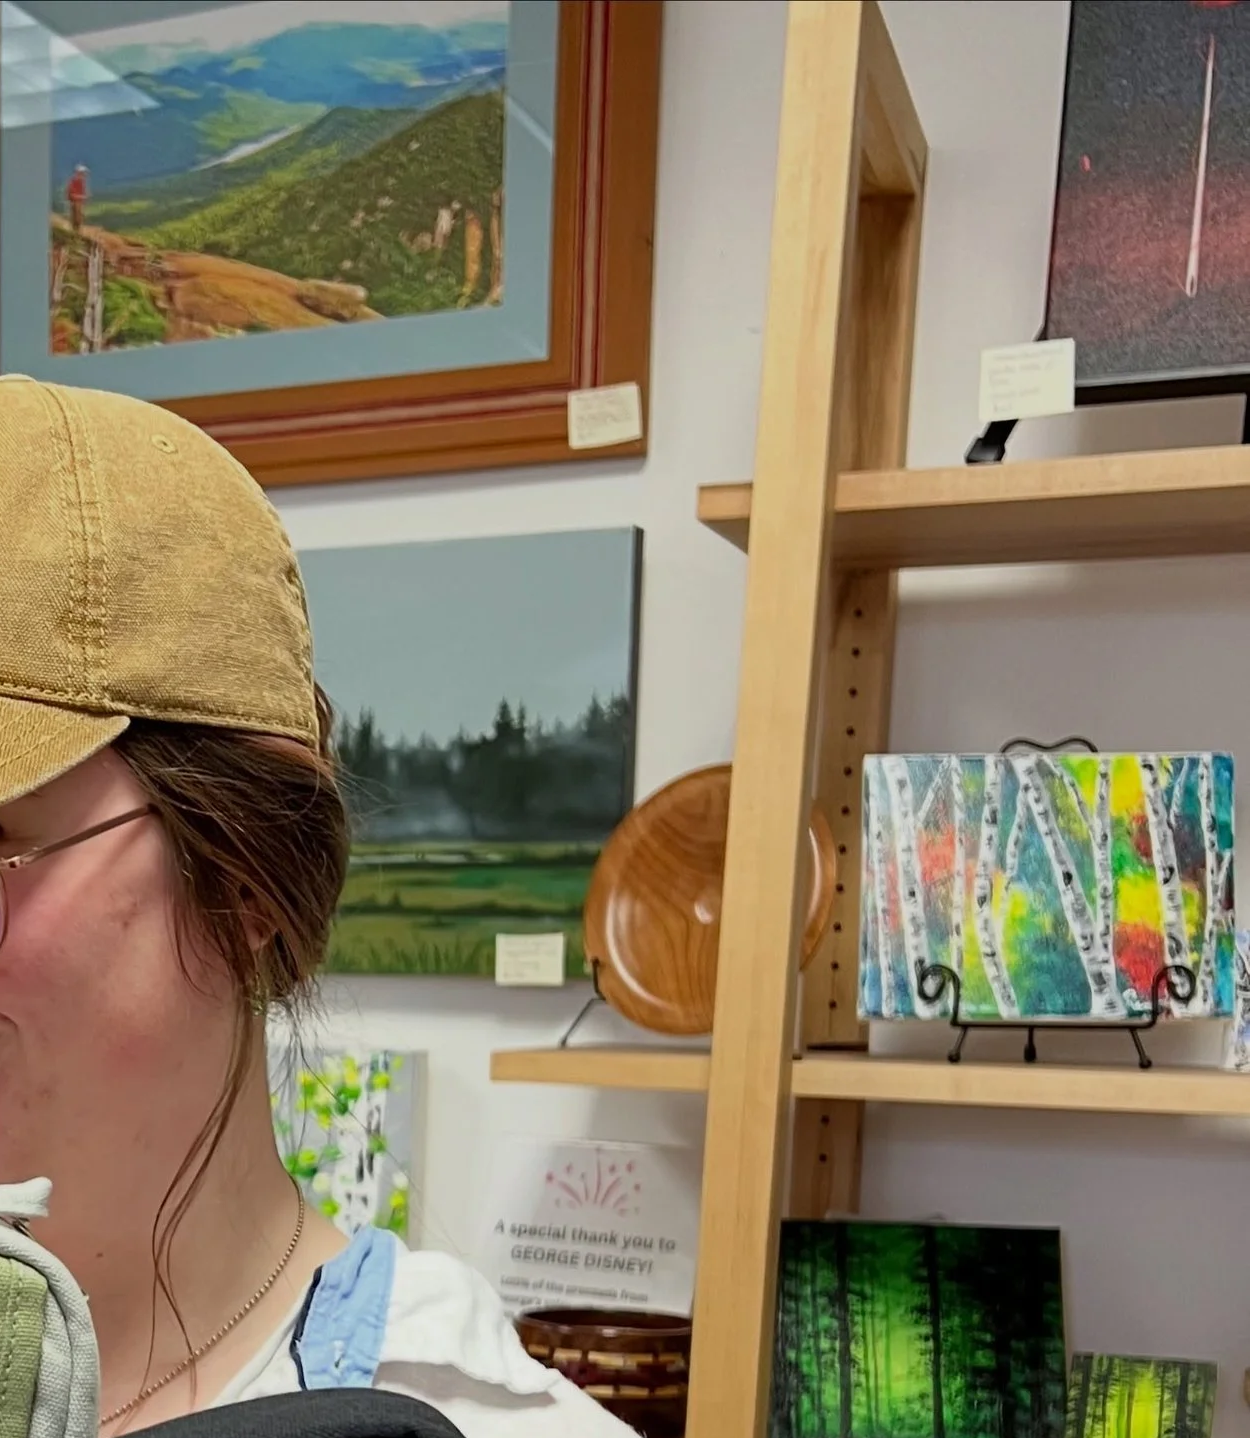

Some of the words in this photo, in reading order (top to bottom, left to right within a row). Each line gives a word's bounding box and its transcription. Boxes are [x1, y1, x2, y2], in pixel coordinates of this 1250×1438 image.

[494, 1218, 505, 1233] A
[509, 1223, 567, 1241] special
[571, 1227, 618, 1246] thank
[622, 1232, 654, 1250] you
[658, 1237, 677, 1250] to
[510, 1244, 580, 1266] GEORGE
[584, 1252, 654, 1275] DISNEY!
